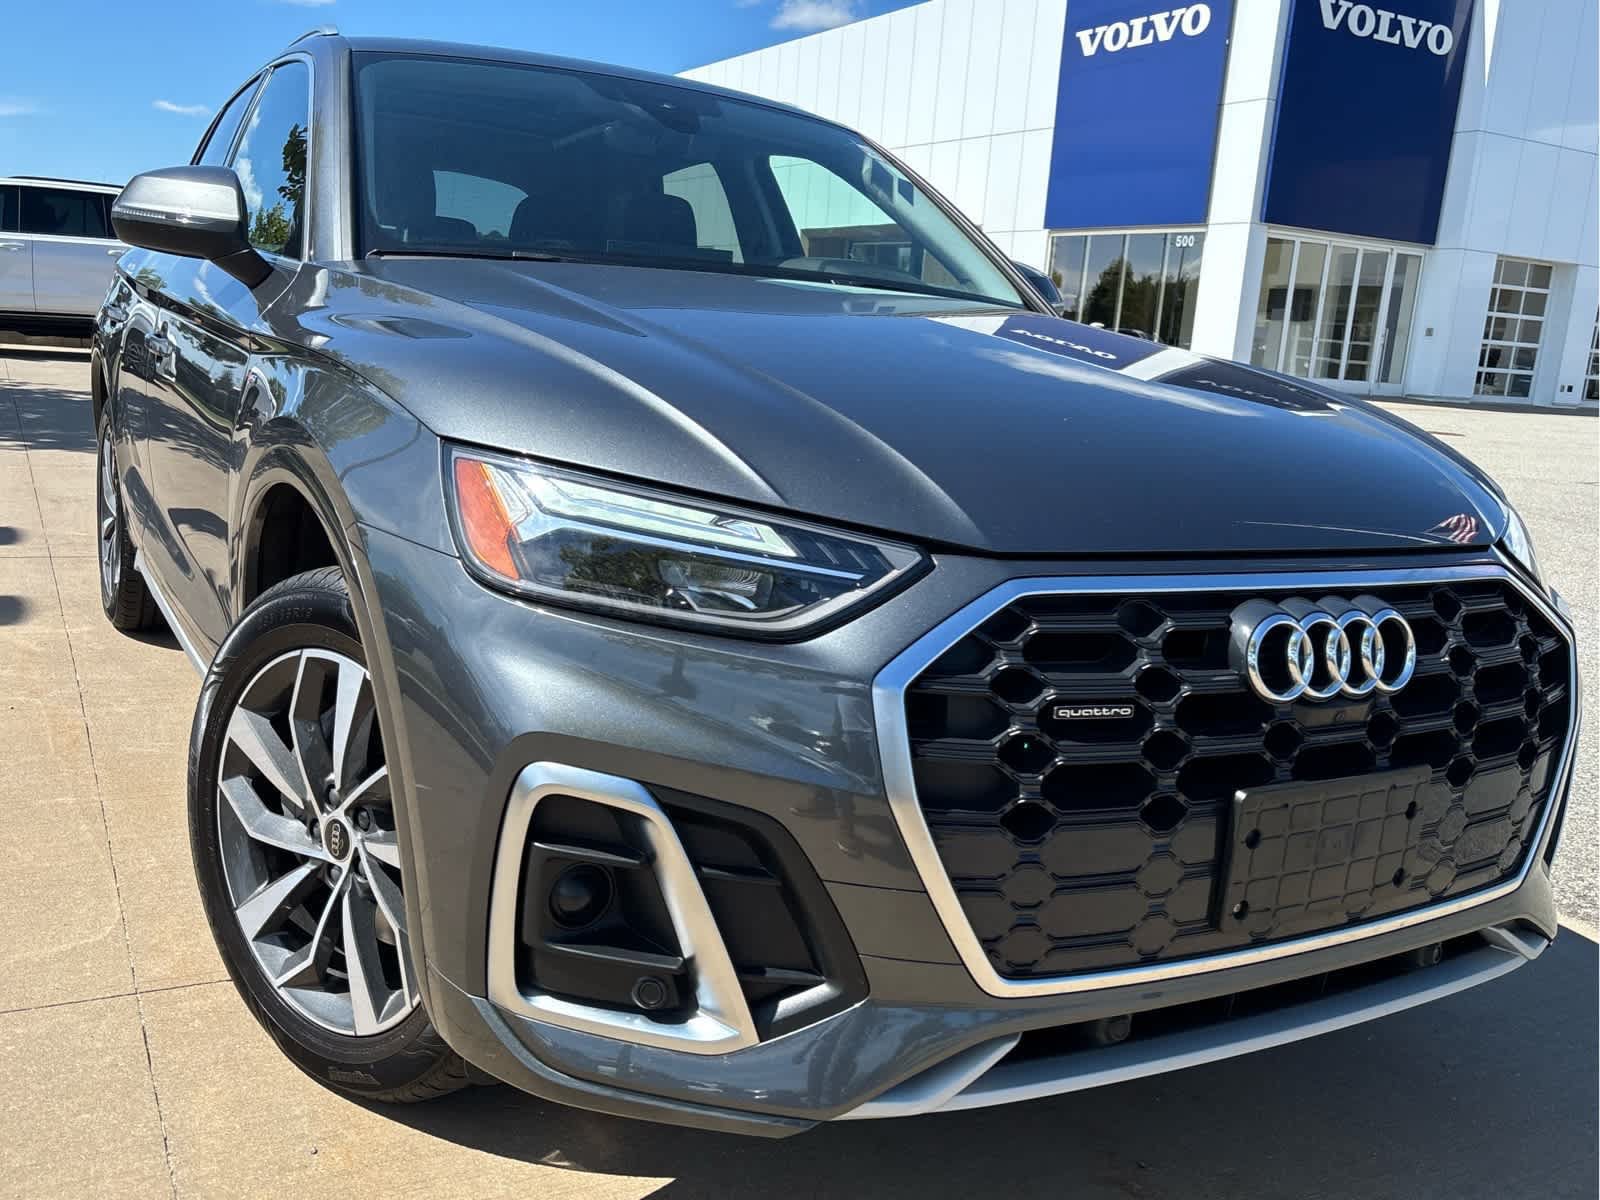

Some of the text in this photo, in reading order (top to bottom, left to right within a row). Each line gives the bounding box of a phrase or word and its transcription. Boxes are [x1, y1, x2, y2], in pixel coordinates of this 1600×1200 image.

[1075, 3, 1211, 57] VOLVO
[1319, 0, 1454, 56] VOLVO
[1175, 234, 1195, 248] 500
[1058, 707, 1131, 718] quattro
